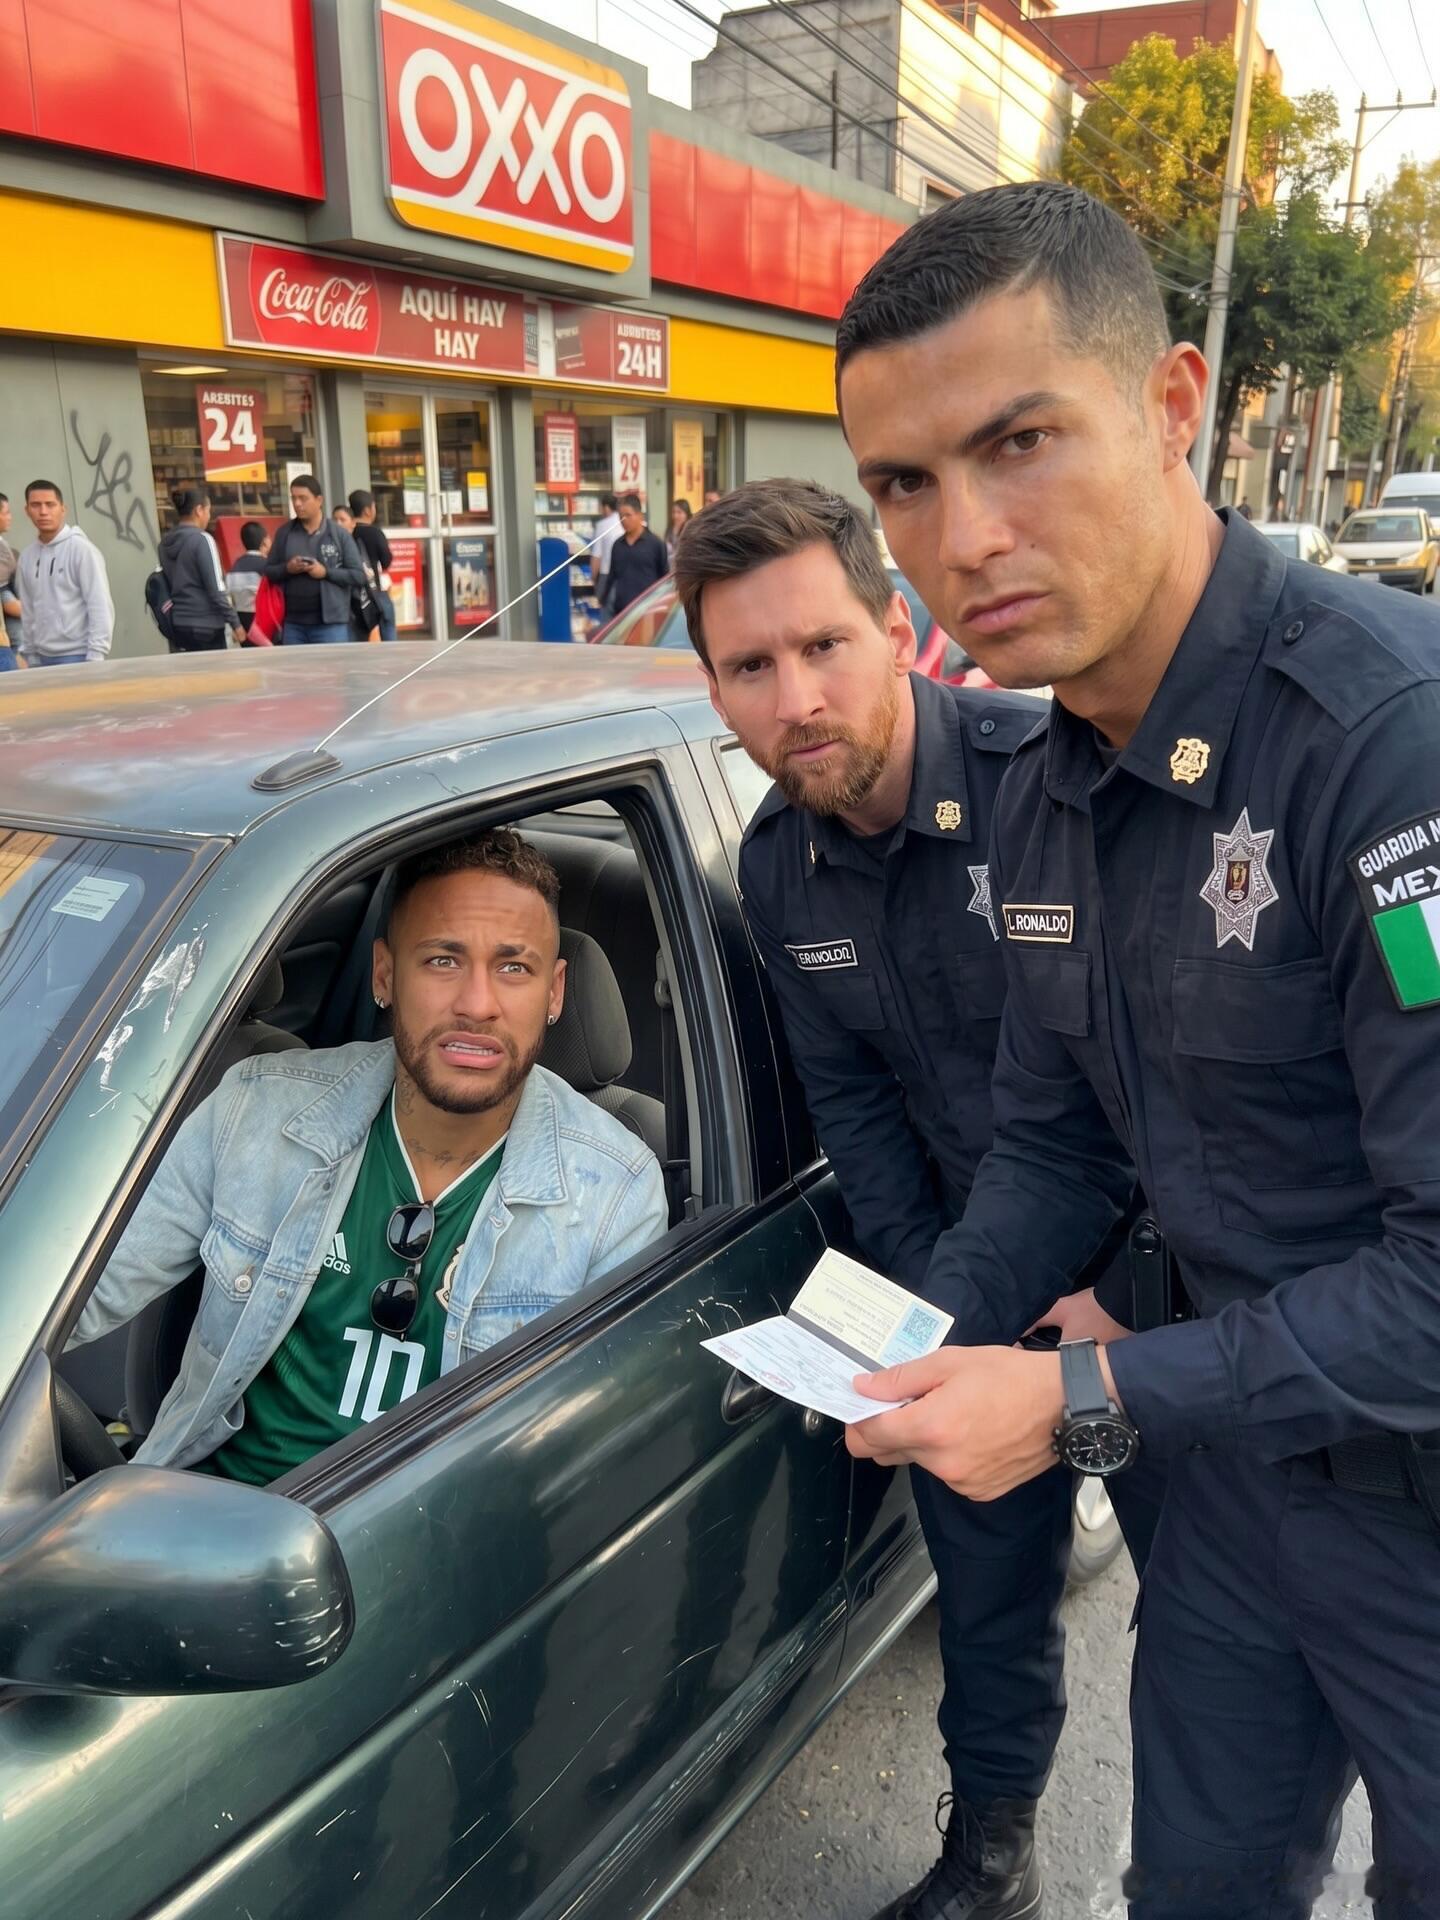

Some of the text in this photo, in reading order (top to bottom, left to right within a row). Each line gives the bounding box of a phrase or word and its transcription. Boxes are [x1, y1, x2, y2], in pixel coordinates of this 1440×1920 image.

[398, 48, 625, 223] OXXO
[259, 268, 373, 331] Coca-Cola
[400, 285, 507, 329] AQUÍ HAY
[434, 328, 480, 360] HAY
[618, 341, 662, 378] 24H
[204, 407, 257, 453] 24
[620, 452, 639, 481] 29
[1358, 825, 1430, 878] GUARDIA
[1372, 865, 1440, 907] MEX
[1015, 914, 1068, 932] RONALDO
[323, 1256, 351, 1274] das
[338, 1326, 426, 1423] 10
